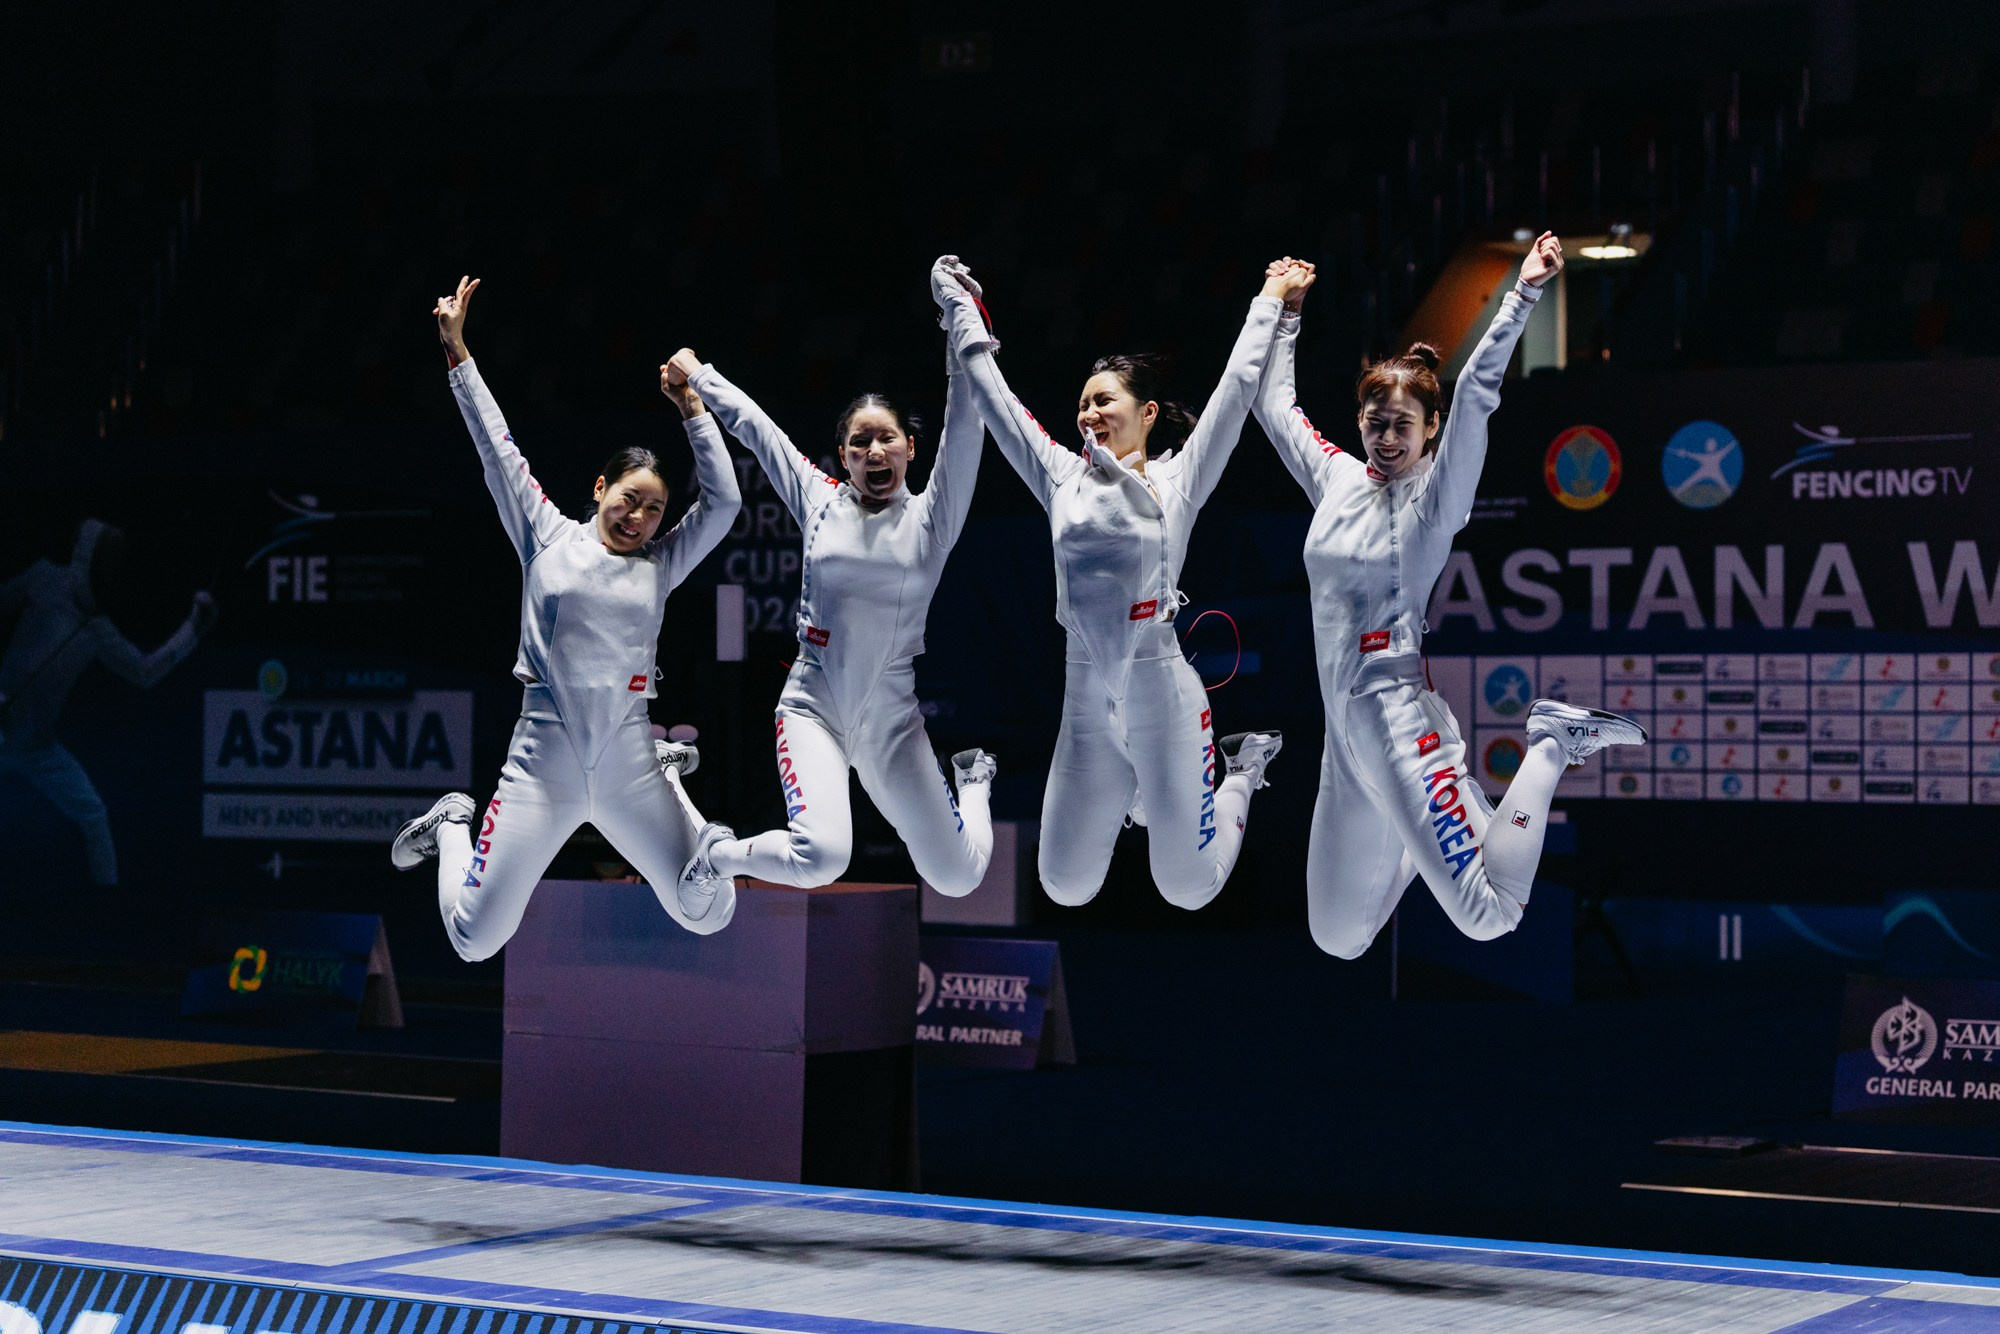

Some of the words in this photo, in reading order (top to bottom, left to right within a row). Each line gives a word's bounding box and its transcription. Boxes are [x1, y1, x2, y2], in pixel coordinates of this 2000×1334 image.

[267, 554, 330, 602] FIE
[725, 550, 799, 584] CUP
[1426, 541, 1876, 633] ASTANA
[217, 709, 453, 770] ASTANA
[1567, 726, 1599, 737] FILA
[660, 752, 689, 765] Kempa
[410, 811, 449, 840] Kempa
[1422, 766, 1480, 881] KOREA
[271, 958, 345, 985] HALYK
[940, 972, 1030, 1002] SAMRUK
[950, 1026, 1023, 1046] PARTNER
[1865, 1076, 1956, 1099] GENERAL
